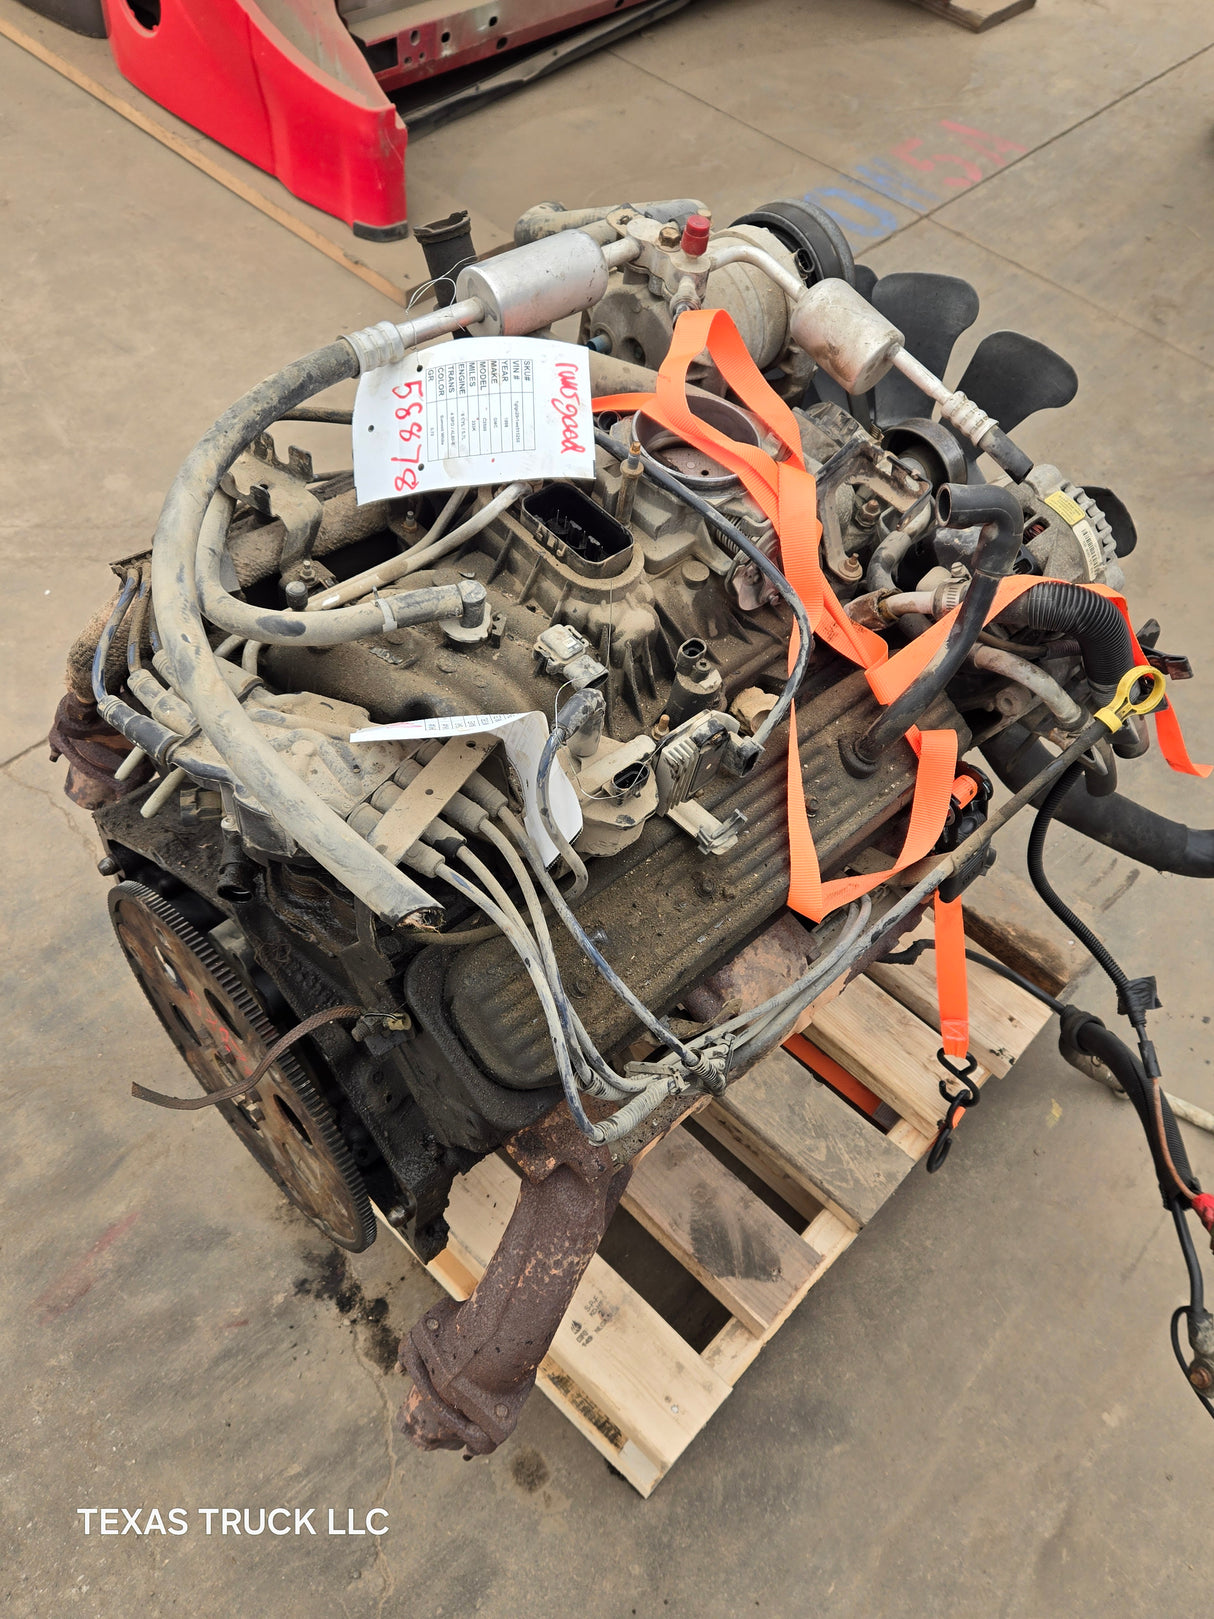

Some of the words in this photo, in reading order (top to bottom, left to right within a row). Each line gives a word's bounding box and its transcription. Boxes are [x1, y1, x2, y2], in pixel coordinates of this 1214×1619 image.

[428, 369, 434, 381] GR
[391, 380, 423, 492] 58878
[551, 398, 585, 454] good
